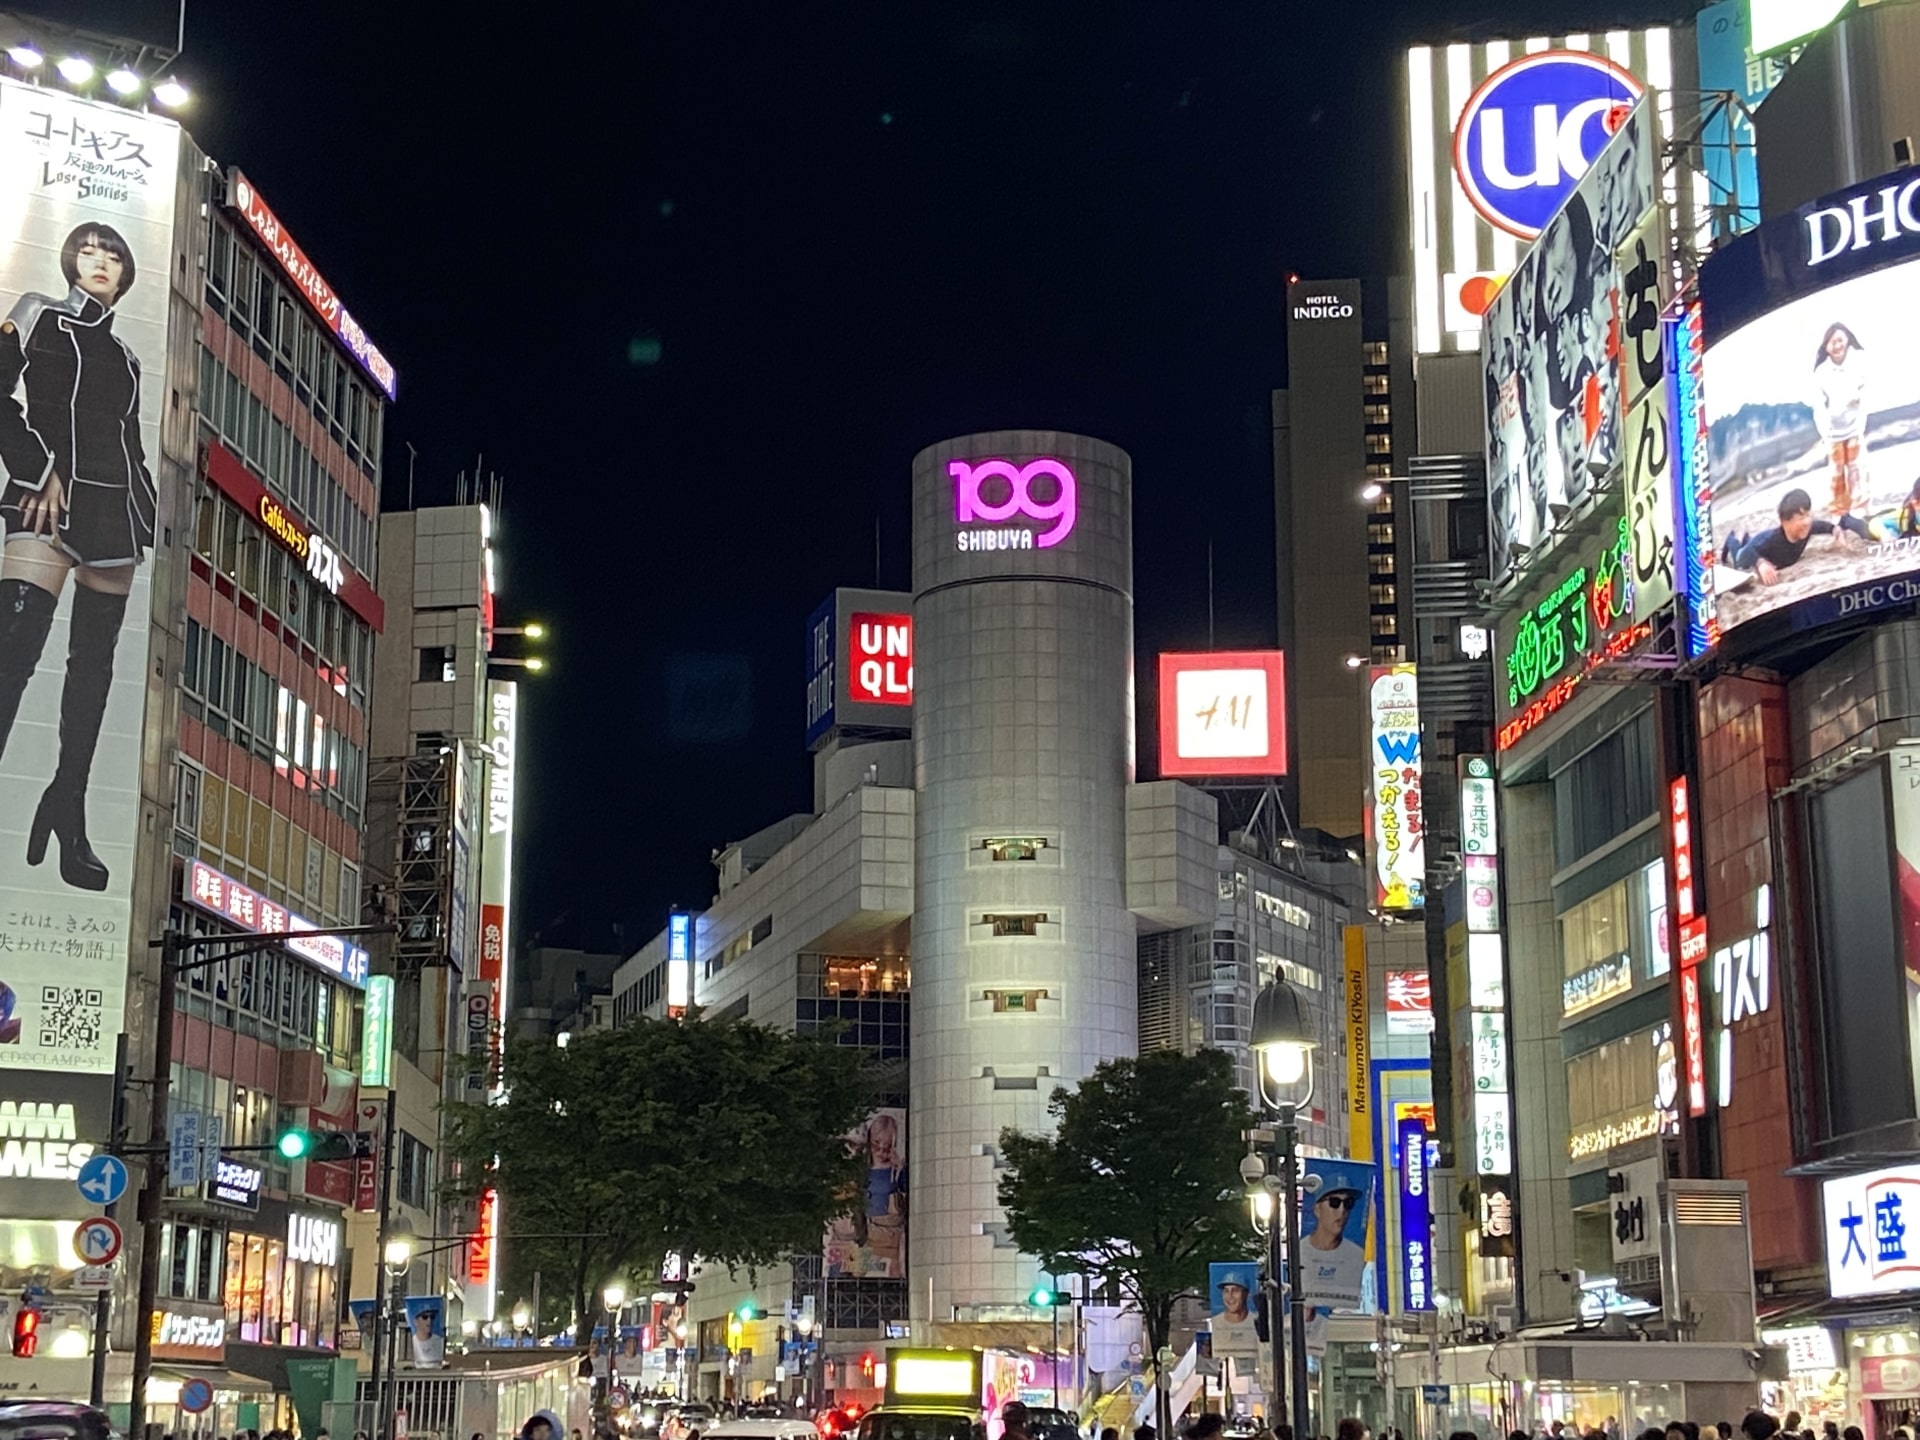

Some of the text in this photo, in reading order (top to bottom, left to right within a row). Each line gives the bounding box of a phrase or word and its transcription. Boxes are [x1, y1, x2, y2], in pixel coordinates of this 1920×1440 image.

[1293, 305, 1353, 320] INDIGO
[1306, 296, 1339, 304] HOTEL
[949, 459, 1077, 548] 109
[957, 528, 1033, 551] SHIBUYA
[1839, 587, 1884, 616] DHC
[860, 623, 908, 658] UN
[488, 692, 511, 834] BIC CAMERA
[1378, 768, 1401, 871] つかえる!
[7, 911, 116, 934] これは、きみの
[483, 924, 501, 961] 免税
[346, 948, 368, 982] 4F
[1713, 932, 1769, 1026] クスリ
[469, 996, 489, 1029] OS
[1354, 1027, 1370, 1114] Matsumoto
[182, 1117, 196, 1180] 渋谷駅前
[1407, 1134, 1423, 1196] MIZUHO
[288, 1213, 337, 1266] LUSH
[1839, 1190, 1907, 1270] 大盛
[1408, 1241, 1425, 1309] みずほ銀行
